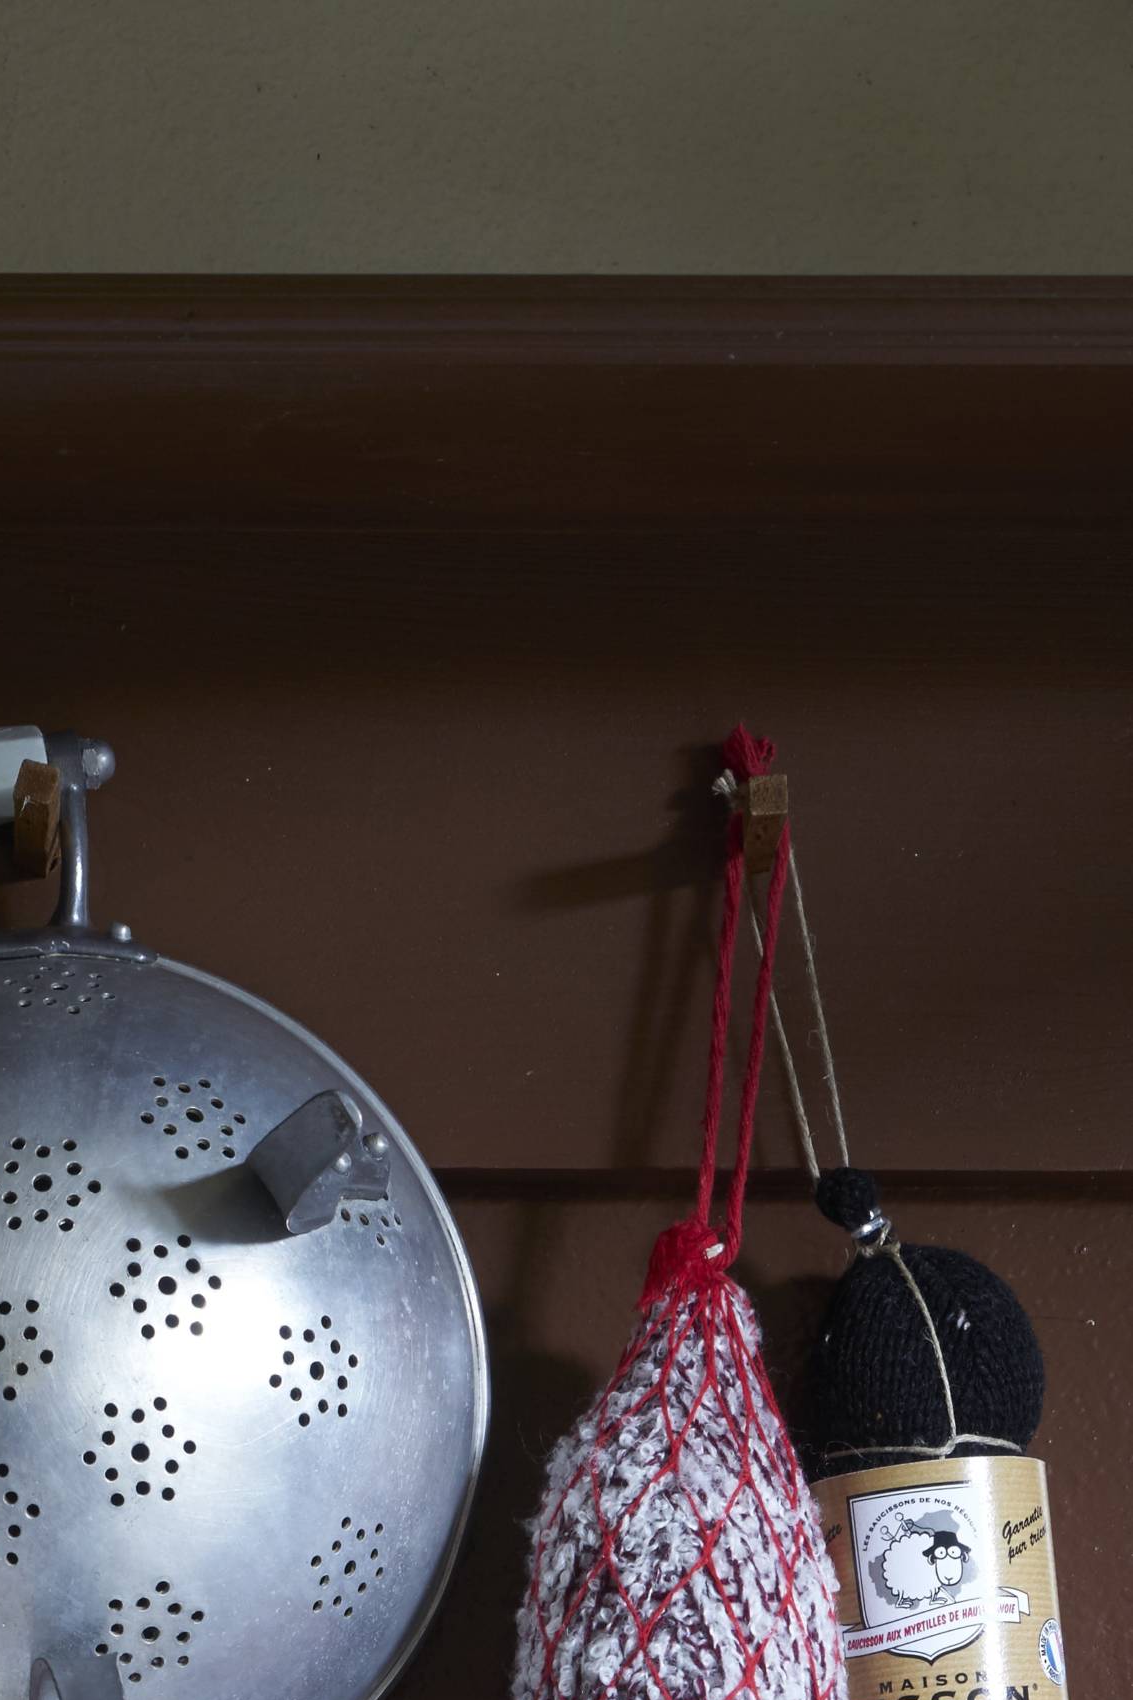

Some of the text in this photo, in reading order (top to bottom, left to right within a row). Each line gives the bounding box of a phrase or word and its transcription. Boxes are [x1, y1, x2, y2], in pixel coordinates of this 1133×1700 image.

[863, 1535, 872, 1552] LES
[868, 1498, 916, 1533] SAUCISSONS
[934, 1498, 952, 1507] NOS
[848, 1634, 884, 1651] SAUCISSON
[886, 1630, 902, 1643] AUX
[904, 1615, 947, 1636] MYRTILLES
[949, 1610, 960, 1622] DE
[879, 1671, 988, 1695] MAISON
